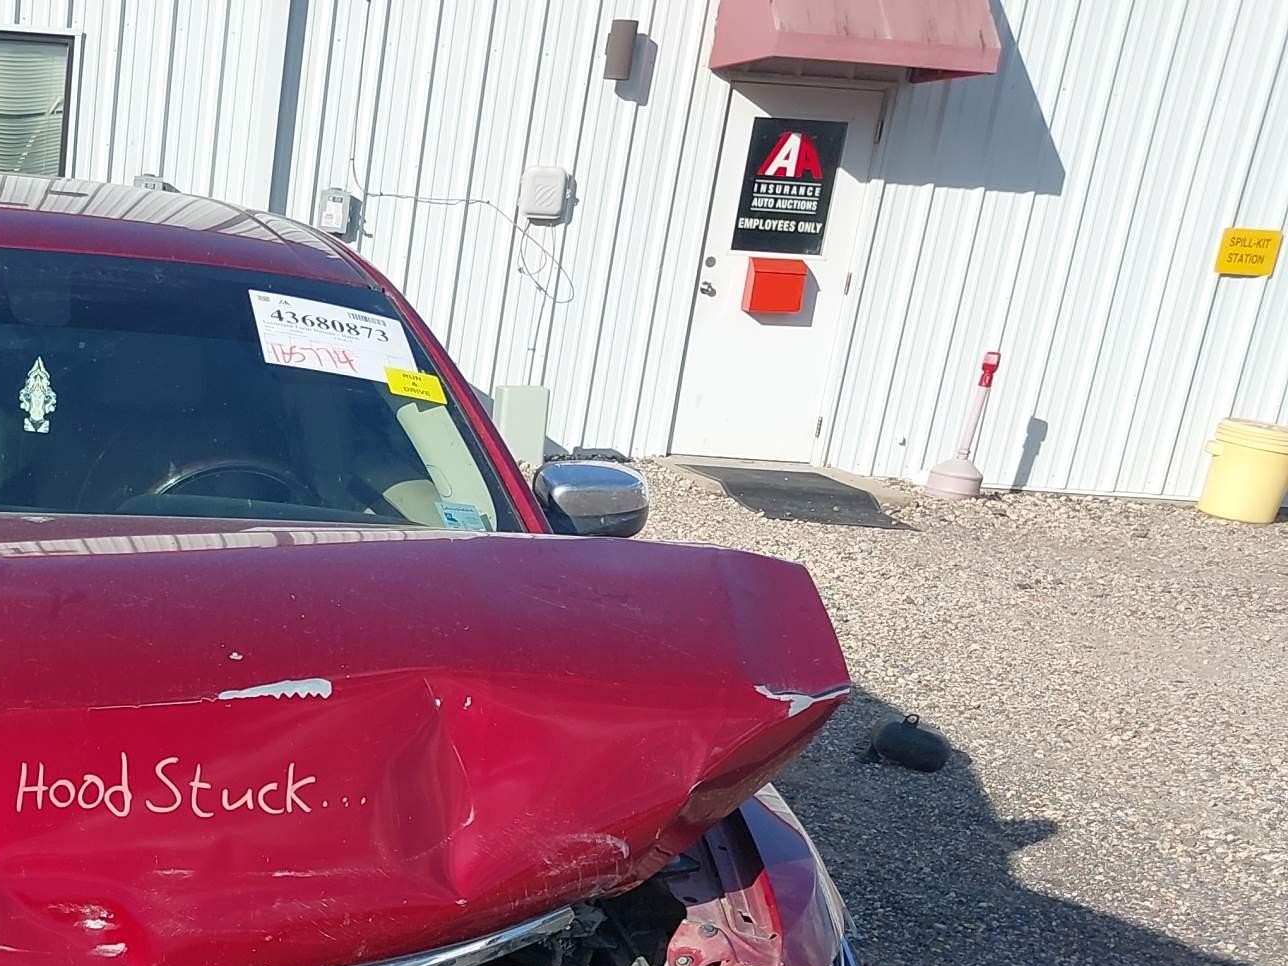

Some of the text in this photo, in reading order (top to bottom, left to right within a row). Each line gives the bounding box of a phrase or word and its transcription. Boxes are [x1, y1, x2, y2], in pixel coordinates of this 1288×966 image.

[753, 183, 822, 197] INSURANCE
[751, 197, 818, 211] AUTO AUCTIONS
[737, 217, 823, 234] EMPLOYEES ONLY
[1229, 236, 1272, 249] SPILL-KIT
[1226, 252, 1265, 265] STATION
[270, 308, 390, 343] 43680873
[16, 751, 133, 818] Hood
